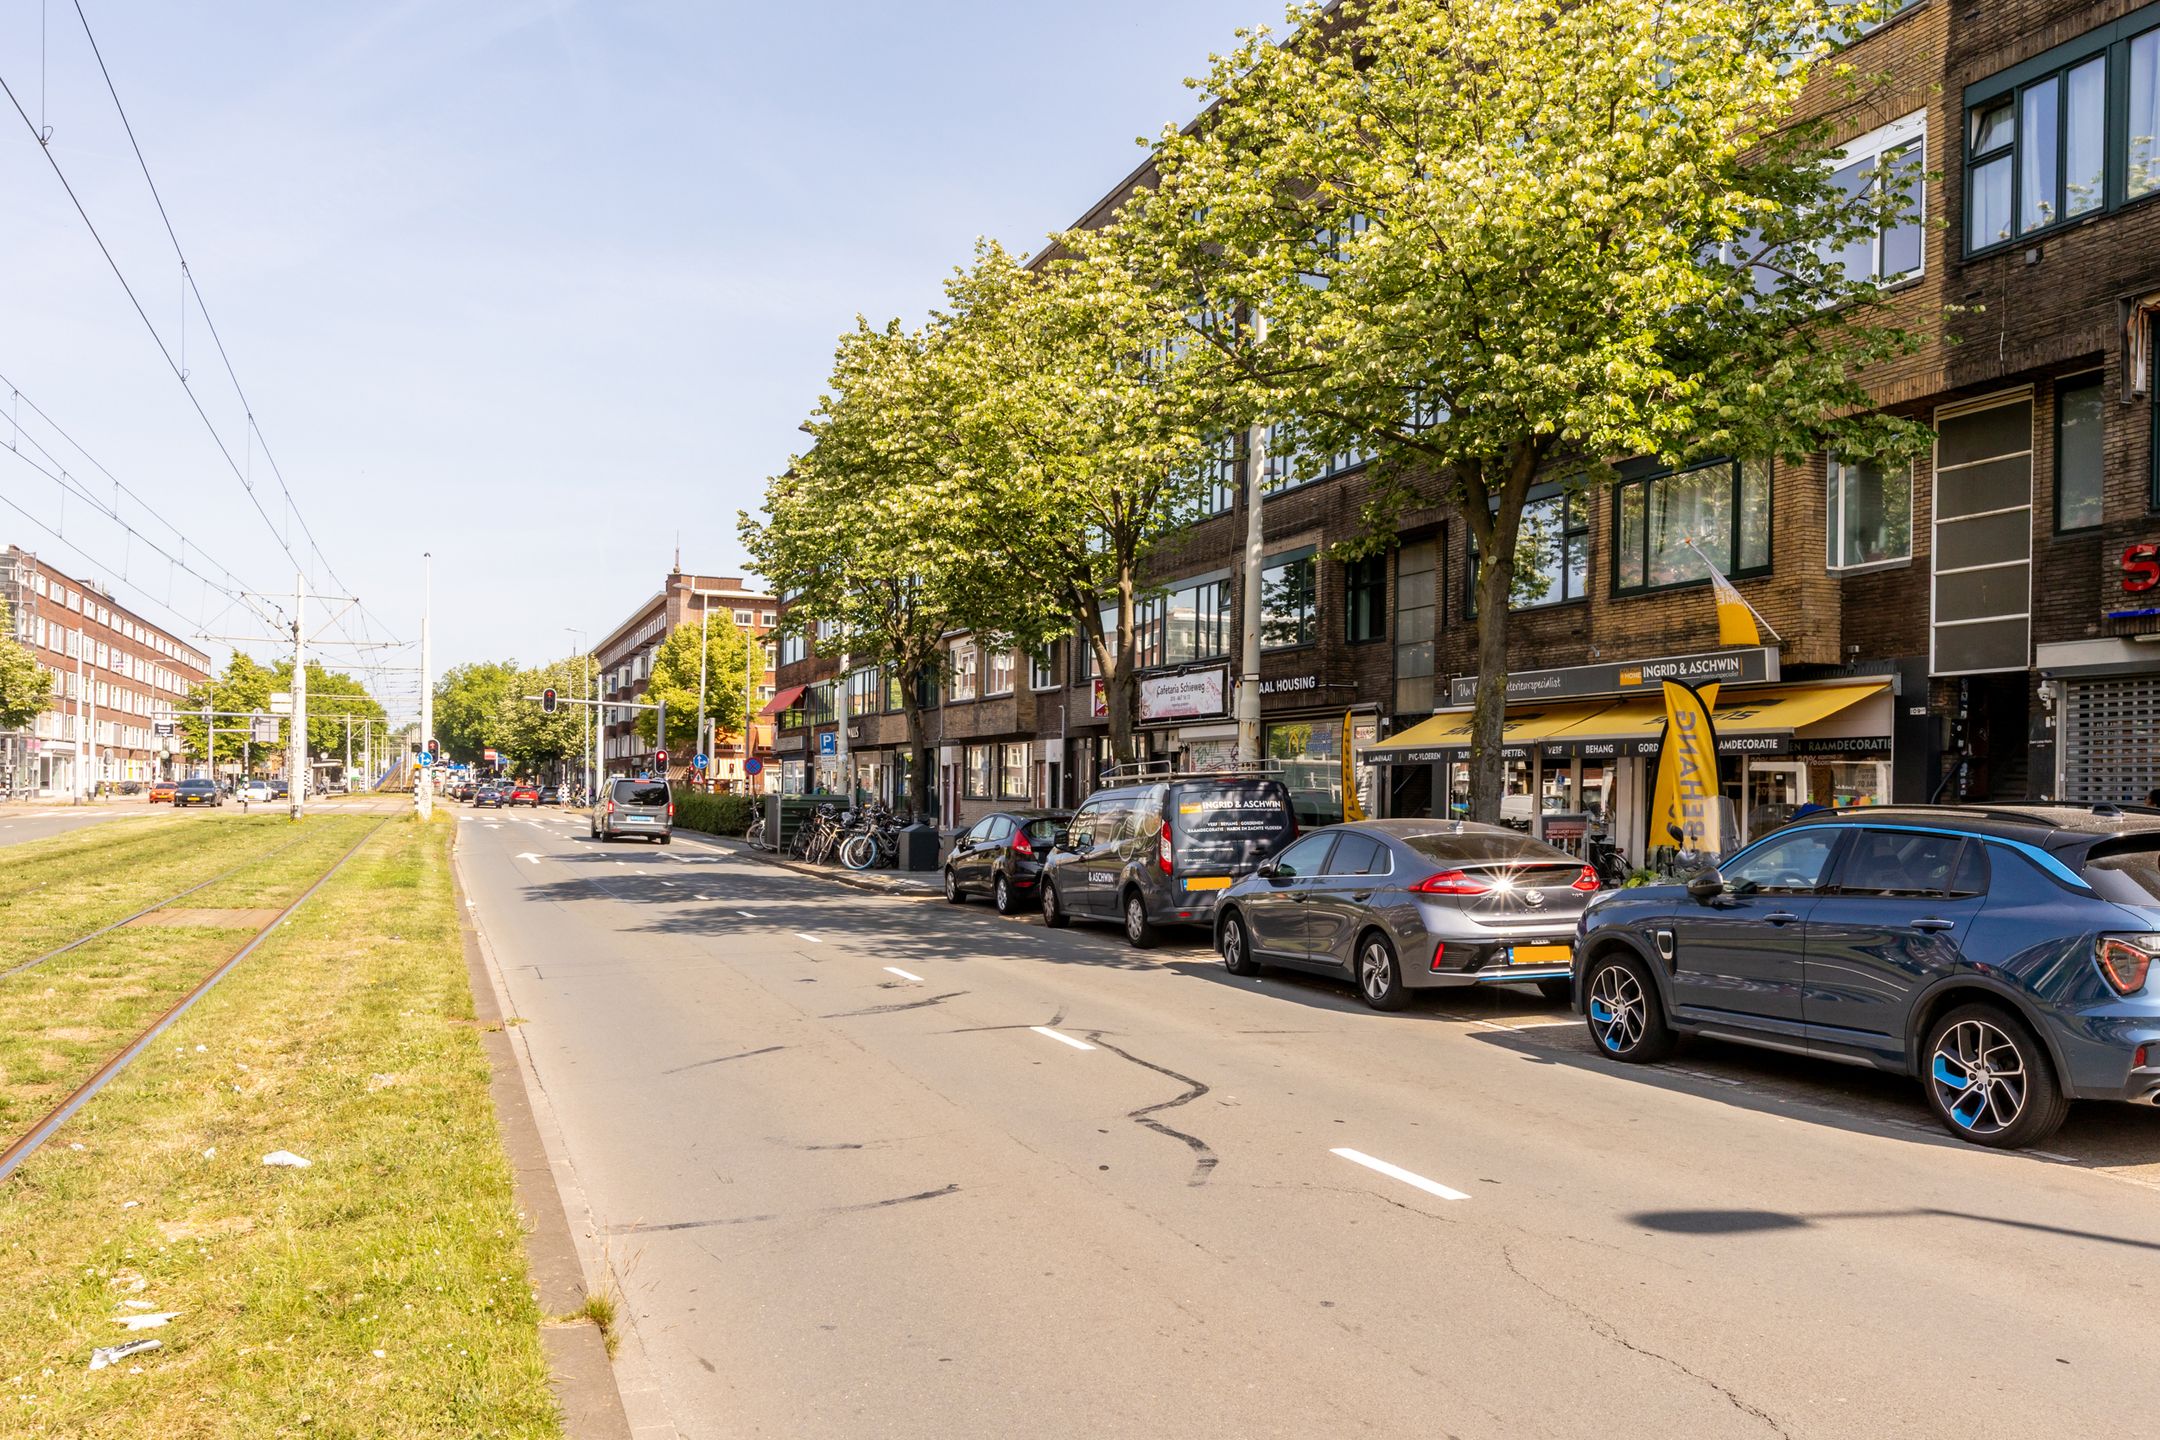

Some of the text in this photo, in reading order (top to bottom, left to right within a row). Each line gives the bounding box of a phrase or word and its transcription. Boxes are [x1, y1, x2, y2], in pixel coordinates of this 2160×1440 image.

[2122, 543, 2160, 591] S
[1643, 657, 1739, 678] INGRID & ASCHWIN
[1157, 681, 1205, 696] Cafetaria Schieweg
[1259, 676, 1316, 694] AAL HOUSING
[1505, 677, 1561, 693] nterieurspecialist
[823, 735, 831, 747] P
[1548, 738, 1778, 754] VERF BEHANG GORD AMDECORATIE
[1408, 752, 1441, 761] PVC-VLOEREN
[1501, 749, 1528, 757] RPETTEN
[1202, 801, 1234, 809] INGRID
[1235, 800, 1241, 808] &
[1243, 800, 1281, 808] ASCHWIN
[1092, 872, 1114, 882] ASCHWIN
